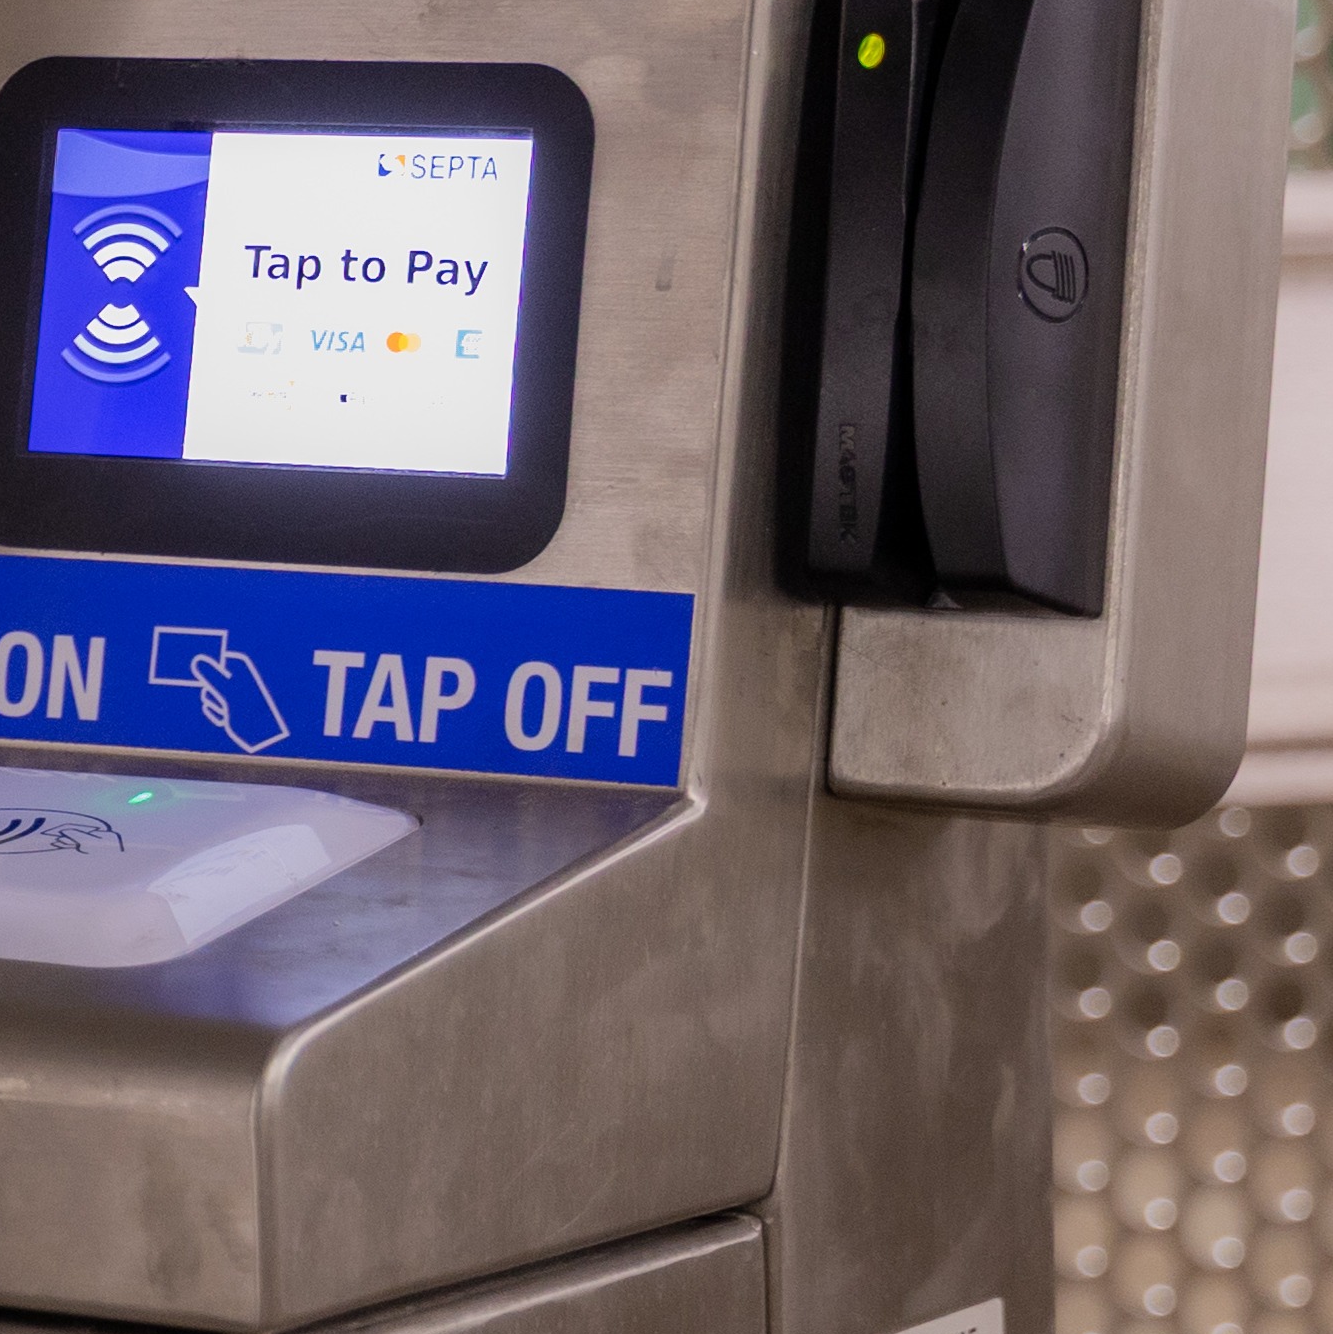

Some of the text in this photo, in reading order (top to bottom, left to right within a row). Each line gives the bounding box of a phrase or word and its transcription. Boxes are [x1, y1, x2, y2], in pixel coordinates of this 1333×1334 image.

[410, 154, 498, 181] SEPTA
[244, 245, 489, 296] Tap to Pay
[310, 329, 366, 353] VISA
[313, 650, 672, 757] TAP OFF
